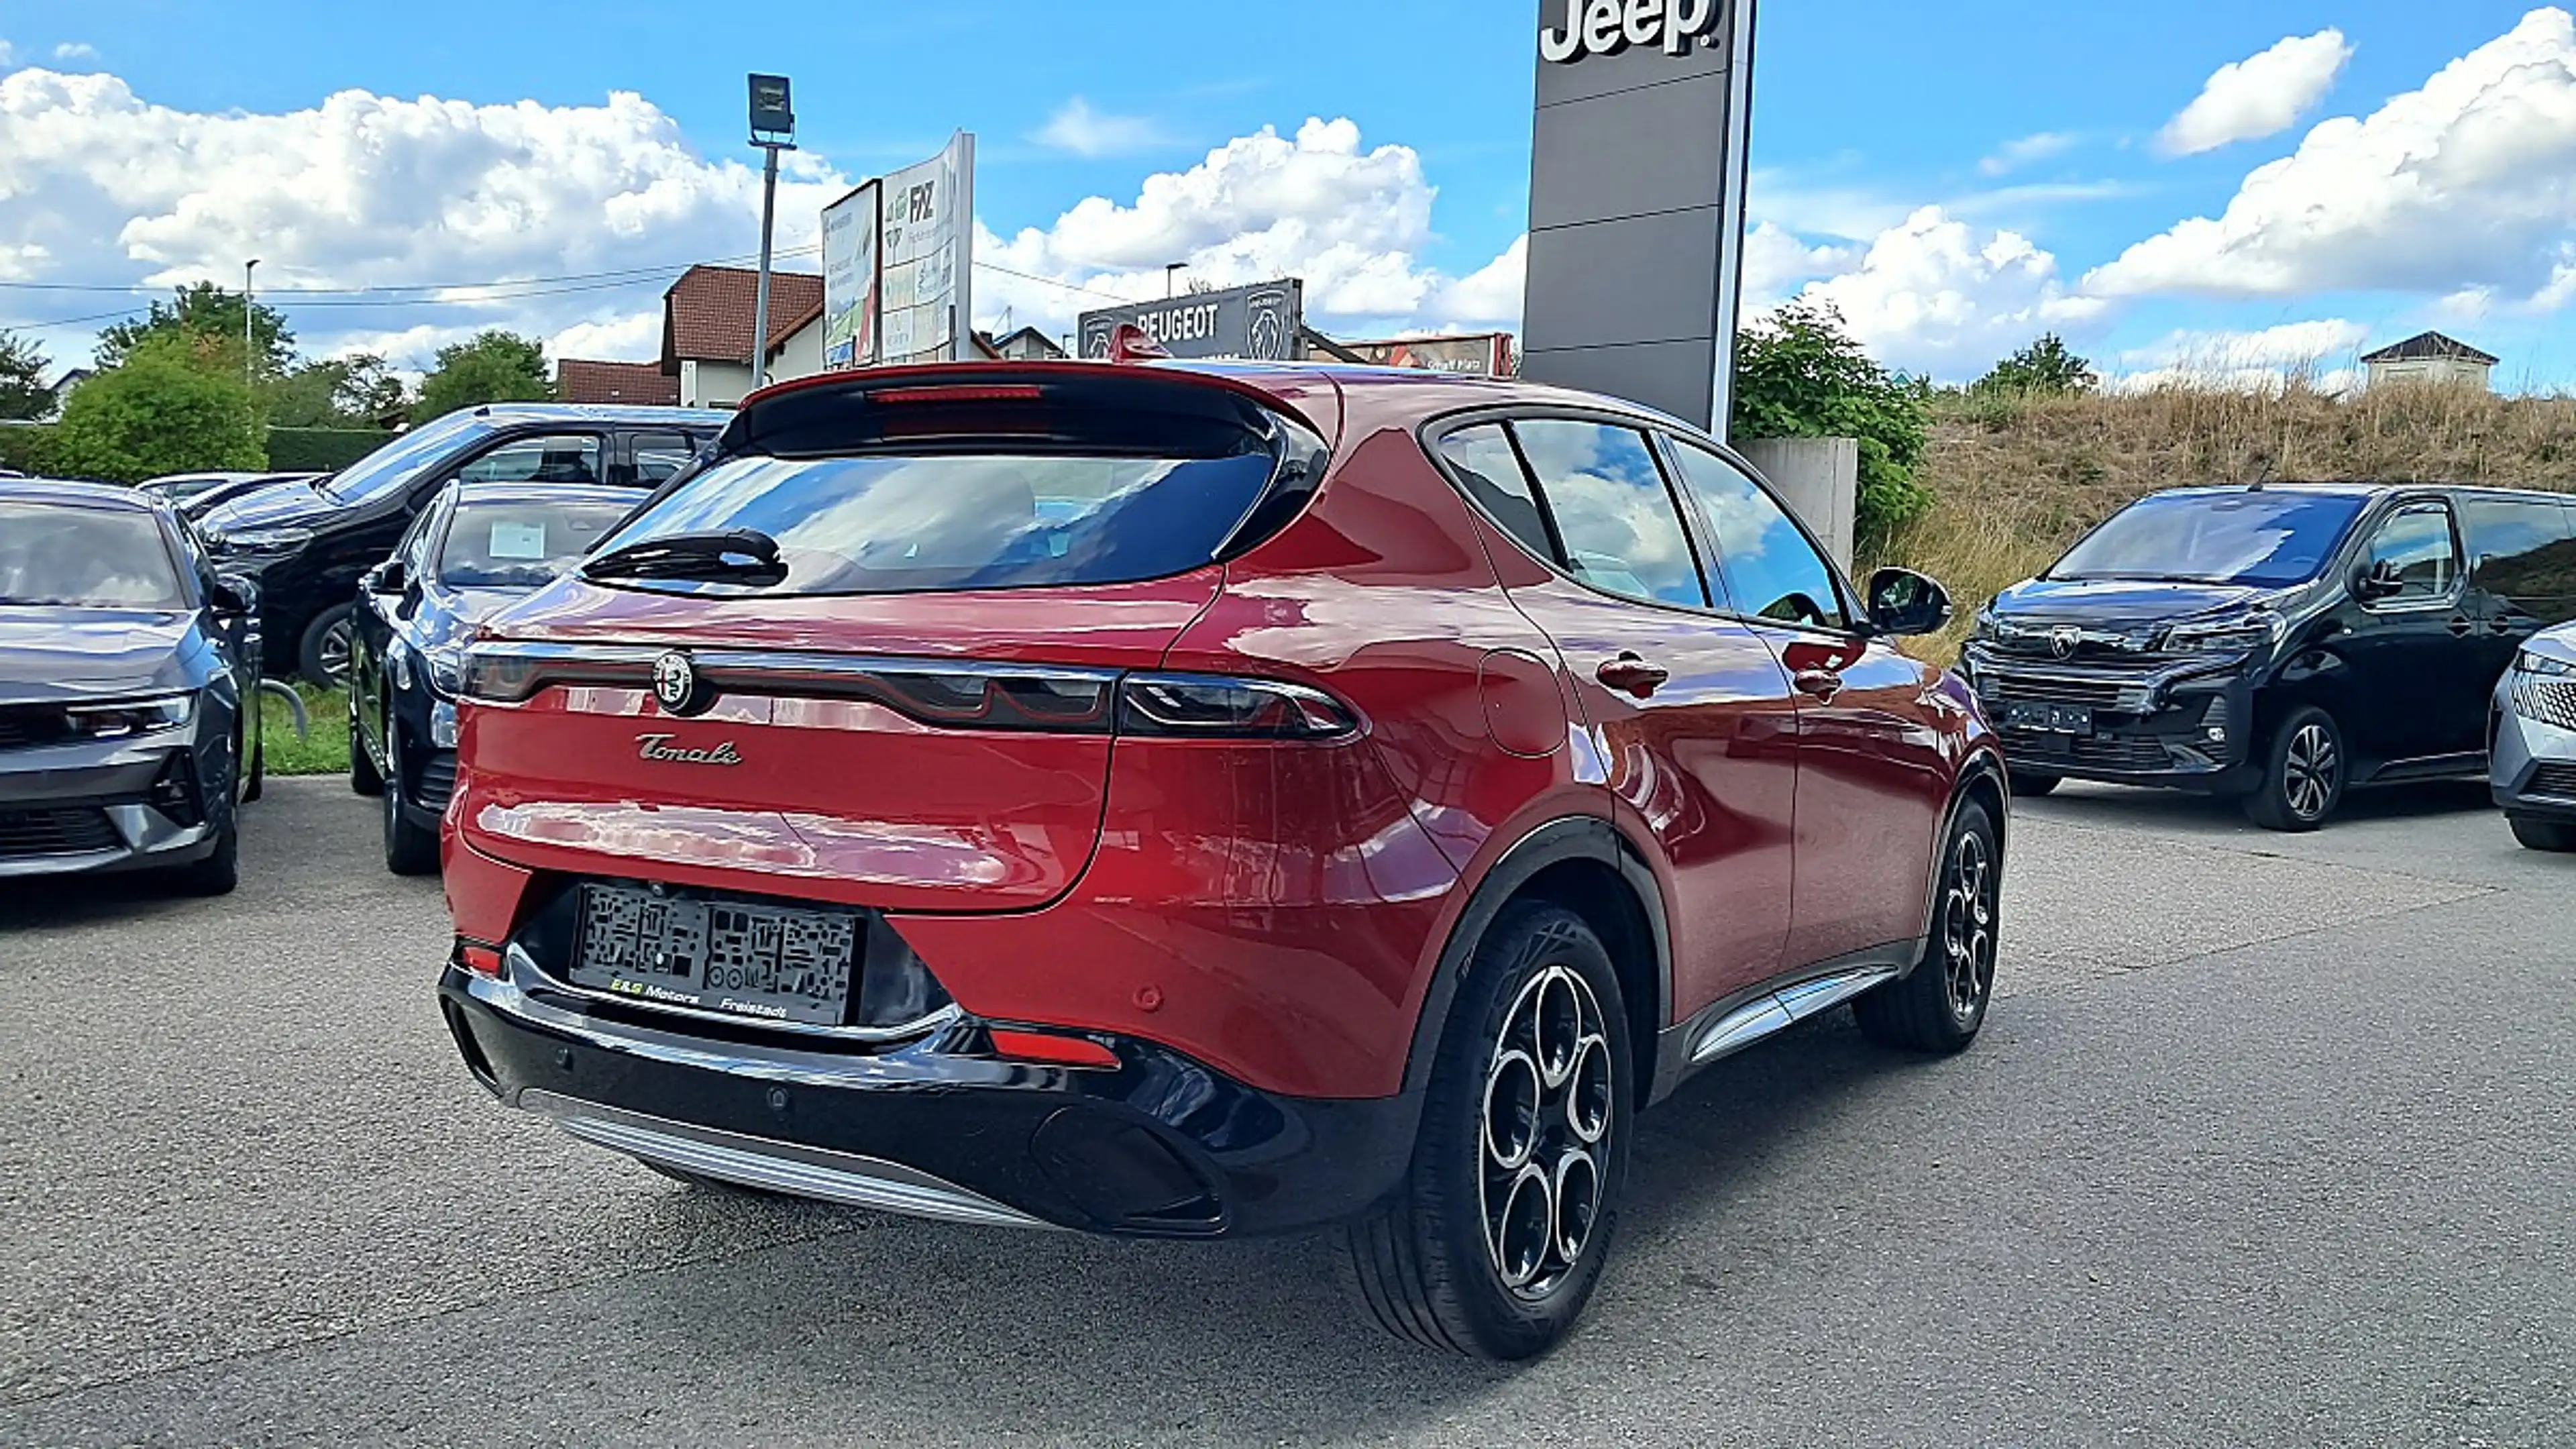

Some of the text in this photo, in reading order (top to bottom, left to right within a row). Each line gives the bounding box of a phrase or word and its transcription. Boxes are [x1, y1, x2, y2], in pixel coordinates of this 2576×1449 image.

[1541, 0, 1710, 61] Jeep
[1138, 304, 1218, 343] PEUGEOT
[634, 733, 743, 765] Tonale
[645, 984, 700, 1005] Motors
[719, 998, 787, 1018] Freistadt
